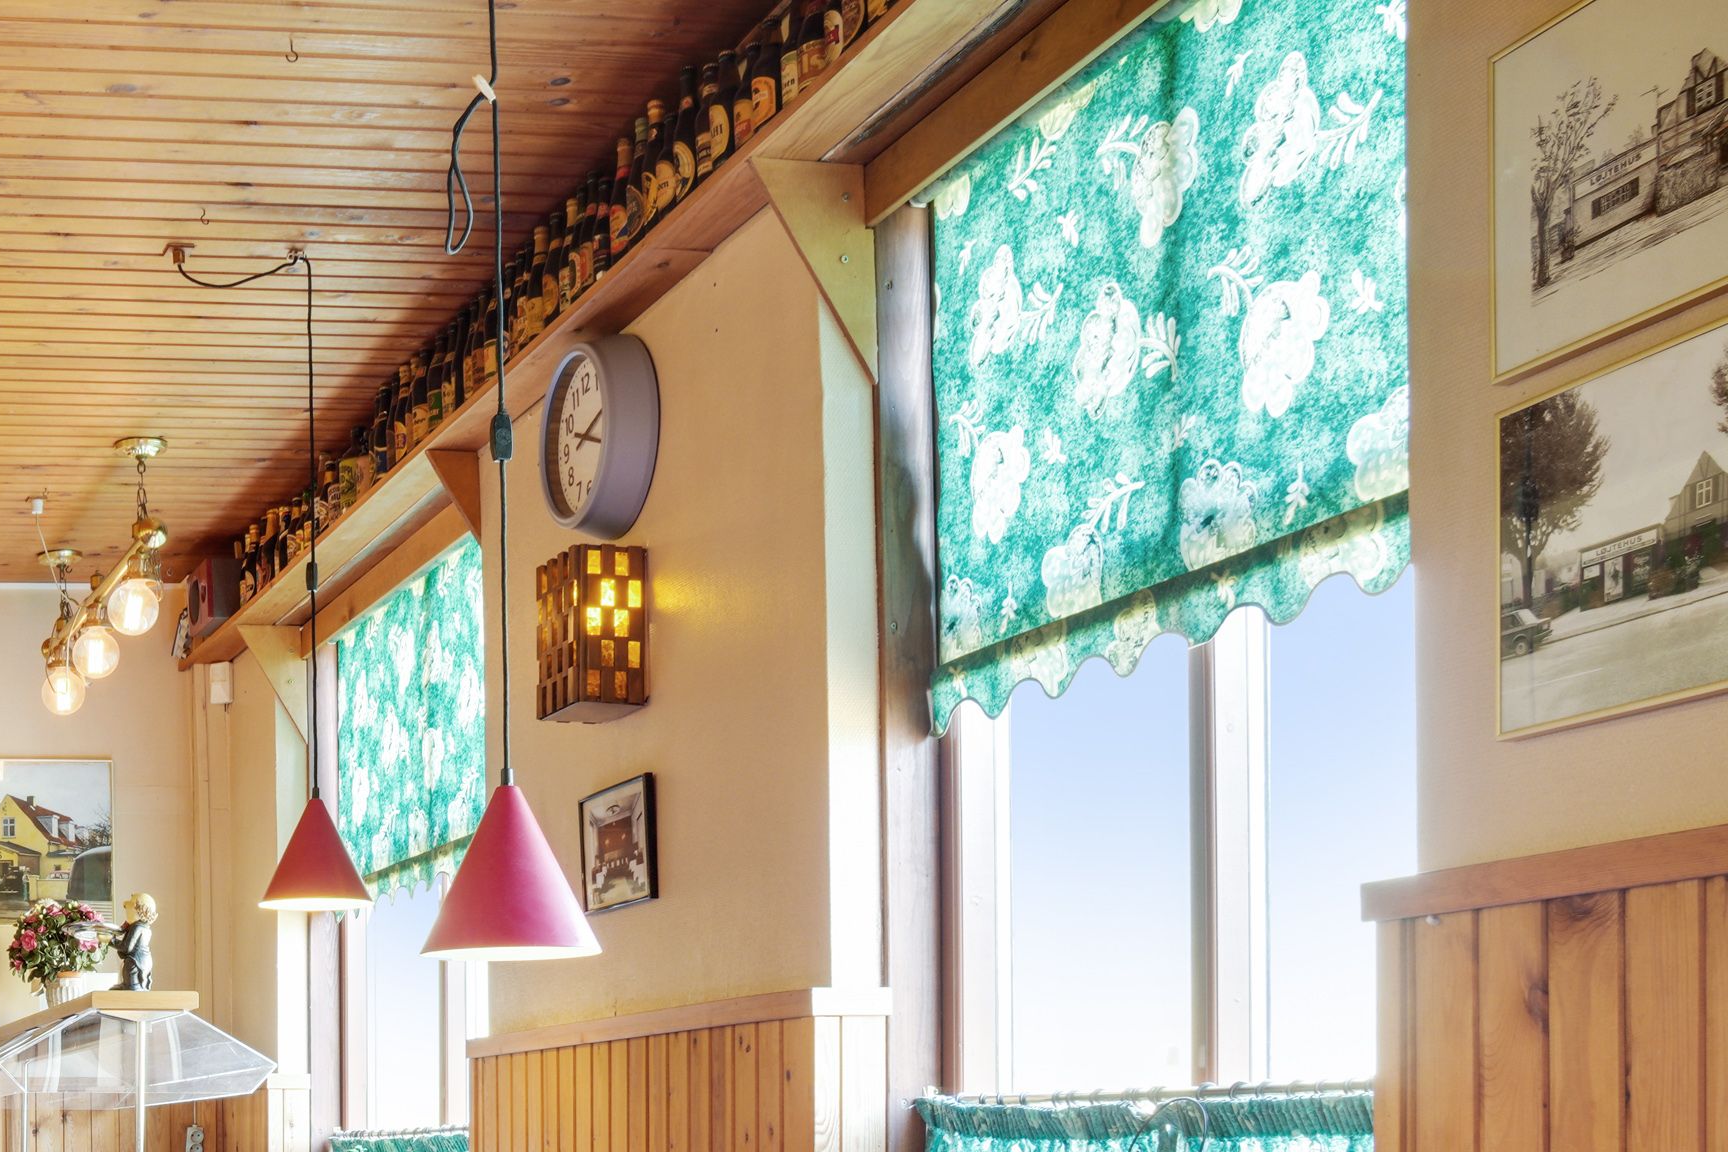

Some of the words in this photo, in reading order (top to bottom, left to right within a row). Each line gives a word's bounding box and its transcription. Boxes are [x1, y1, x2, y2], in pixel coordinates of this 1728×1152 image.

[1589, 152, 1642, 187] LØJTEHUS
[580, 372, 591, 396] 12
[594, 373, 600, 392] 1
[571, 388, 581, 410] 11
[564, 413, 575, 436] 10
[563, 444, 570, 464] 9
[568, 466, 575, 487] 8
[575, 481, 583, 503] 7
[1595, 535, 1643, 557] LØJTEHUS
